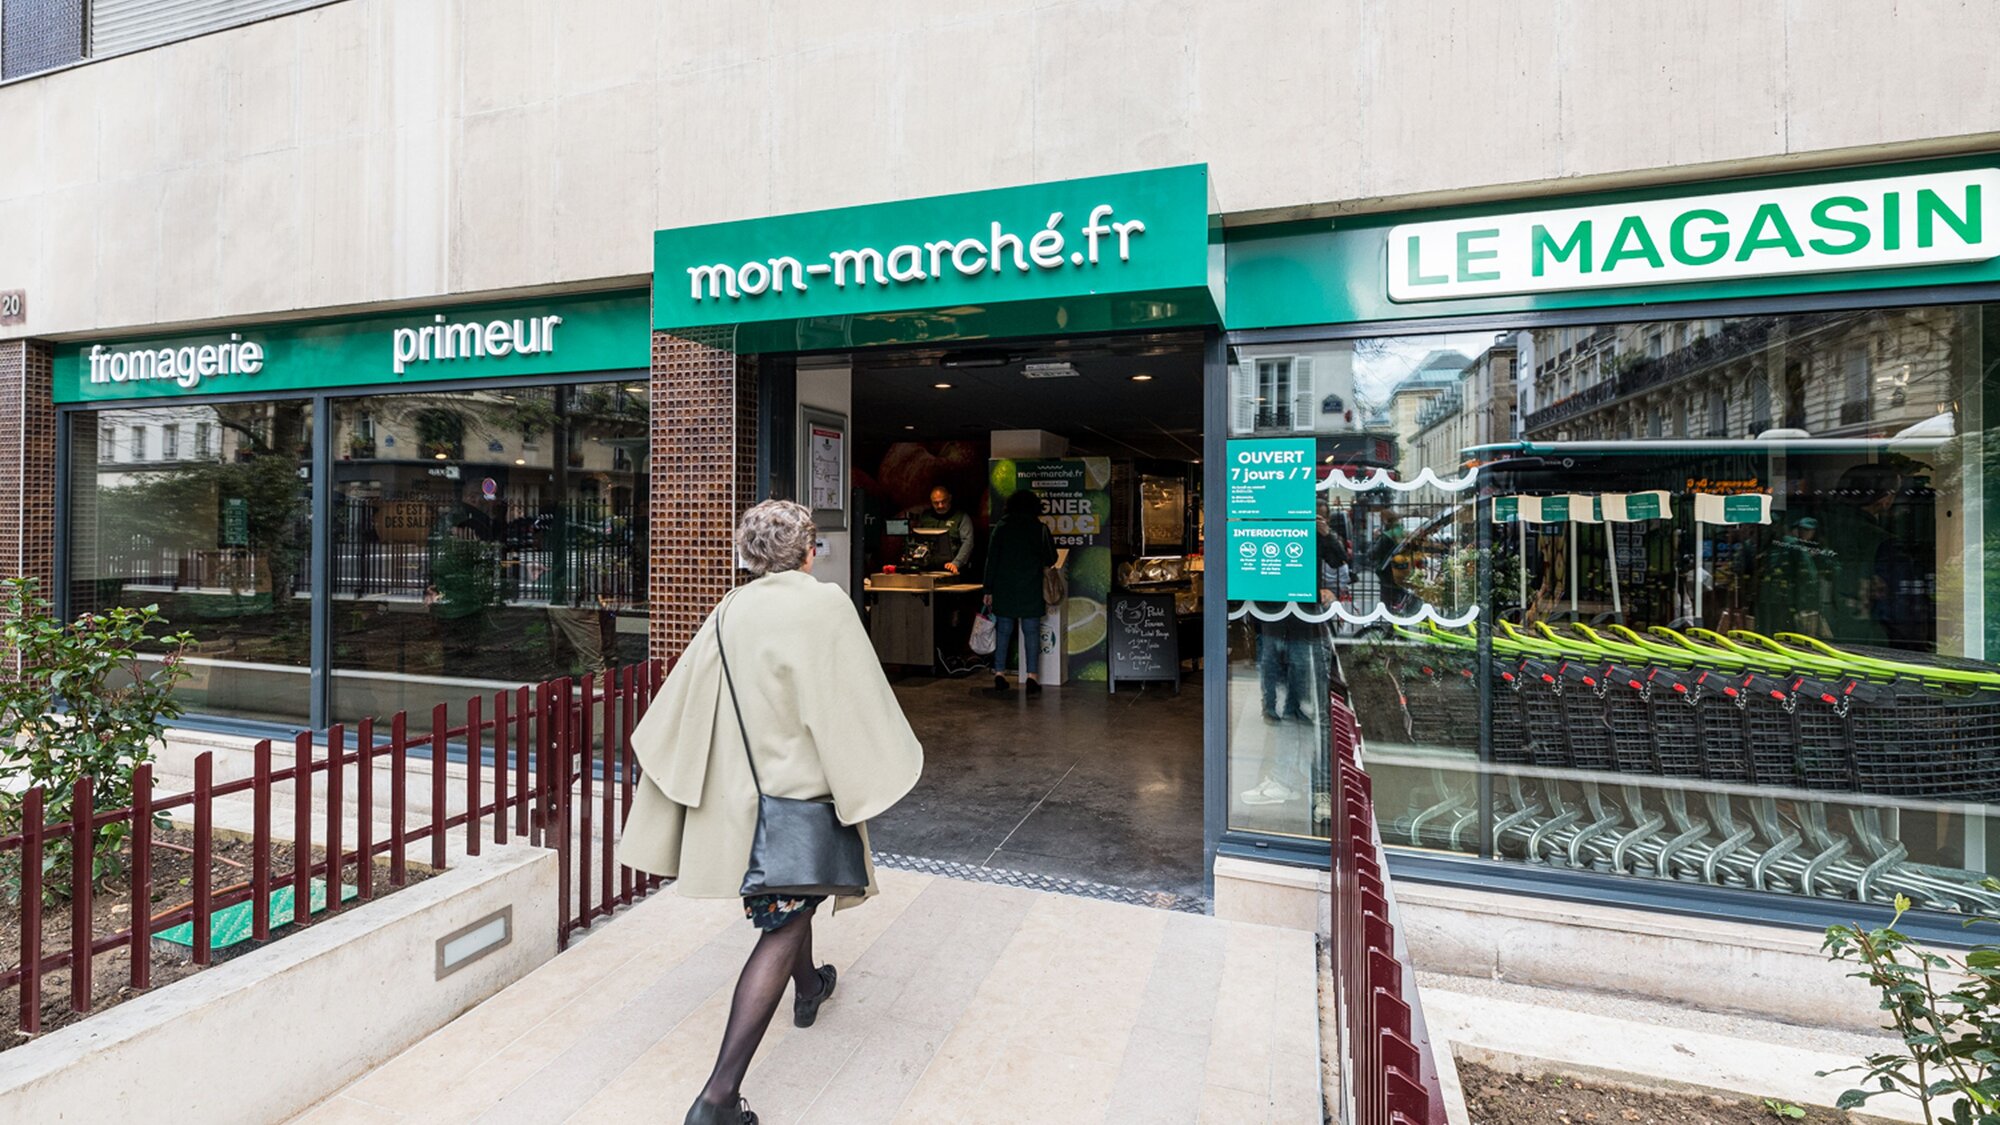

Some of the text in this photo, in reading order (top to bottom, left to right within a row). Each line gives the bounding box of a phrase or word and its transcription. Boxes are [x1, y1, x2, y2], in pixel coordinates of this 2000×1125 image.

[1407, 184, 1982, 286] LE MAGASIN
[687, 204, 1145, 299] mon-marché.fr
[2, 295, 20, 316] 20
[393, 314, 562, 374] primeur
[89, 333, 264, 388] fromagerie
[1238, 450, 1304, 464] OUVERT
[1017, 469, 1084, 478] mon-marché.fr
[1231, 467, 1312, 483] 7 jours / 7
[1040, 499, 1092, 514] GNER
[1039, 514, 1095, 534] 00€
[1233, 528, 1309, 538] INTERDICTION
